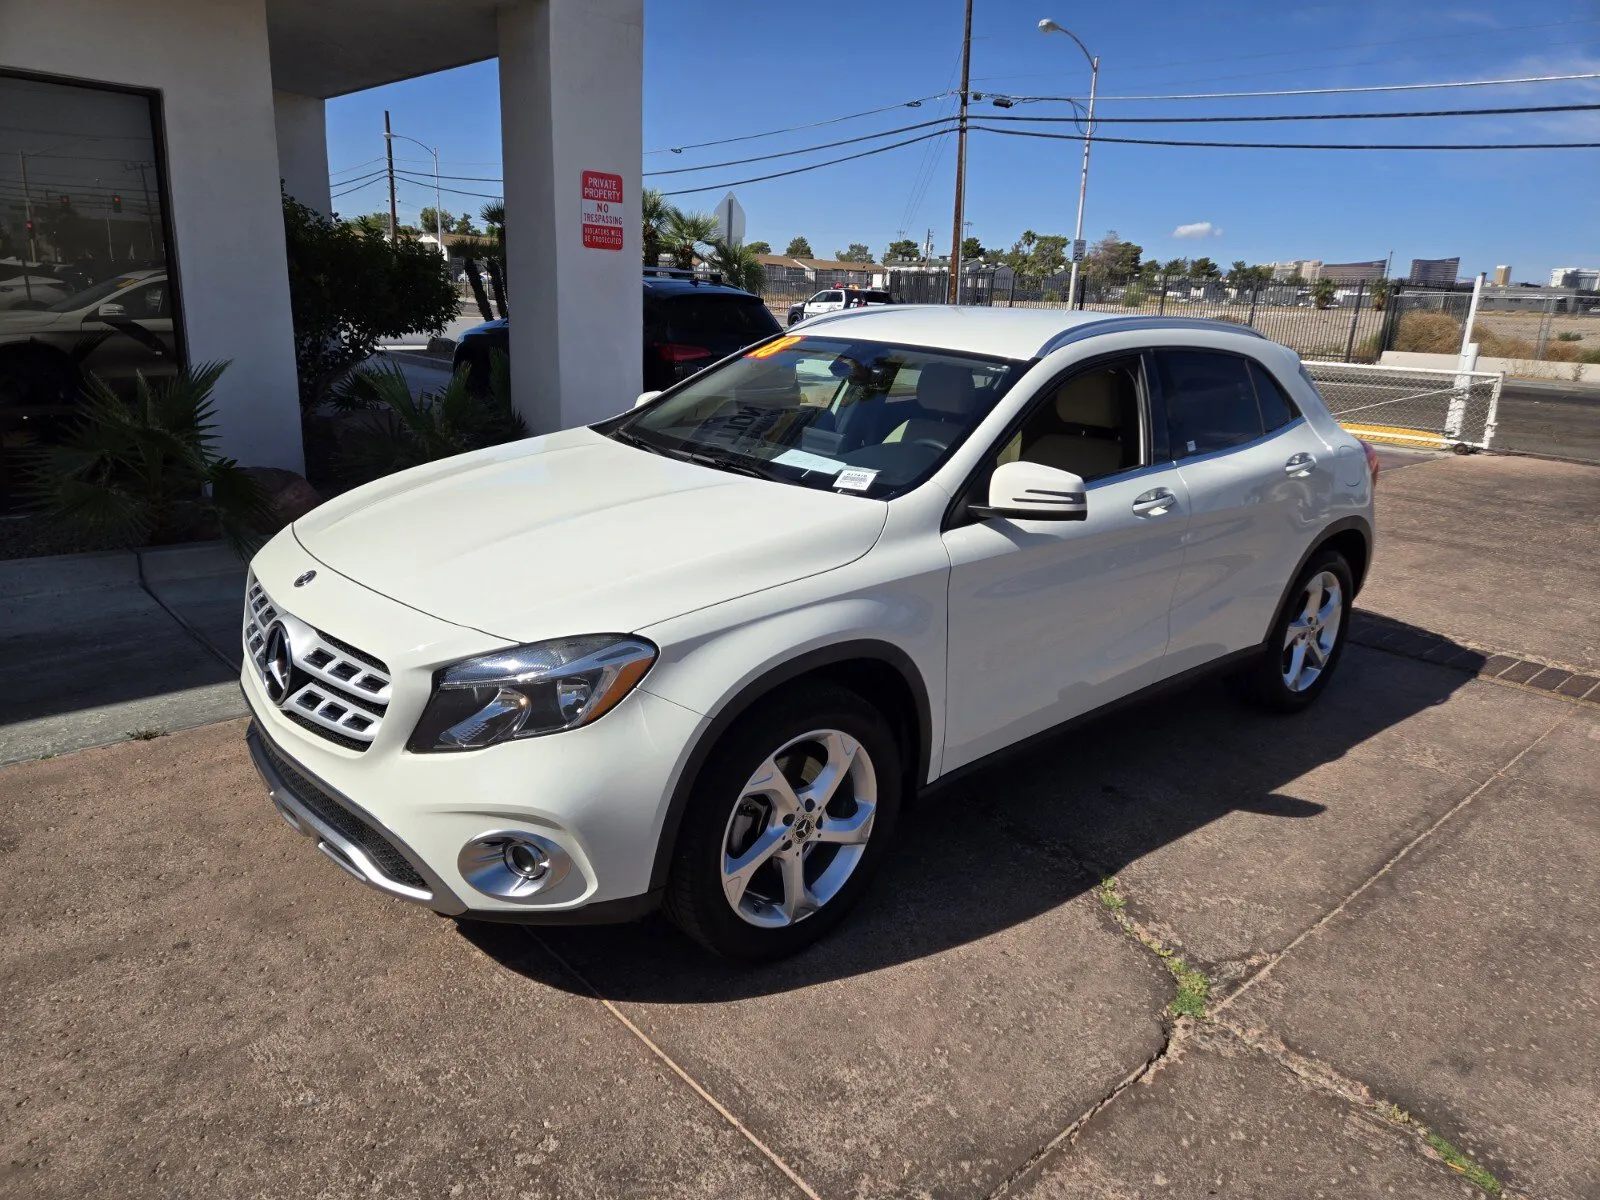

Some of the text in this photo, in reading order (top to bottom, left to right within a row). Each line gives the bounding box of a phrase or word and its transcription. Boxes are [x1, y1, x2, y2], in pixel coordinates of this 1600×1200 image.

[588, 177, 617, 190] PRIVATE
[584, 187, 621, 201] PROPERTY
[596, 202, 609, 213] NO
[583, 212, 623, 226] TRESPASSING
[592, 235, 622, 245] PROSECUTED
[1073, 252, 1084, 261] 25
